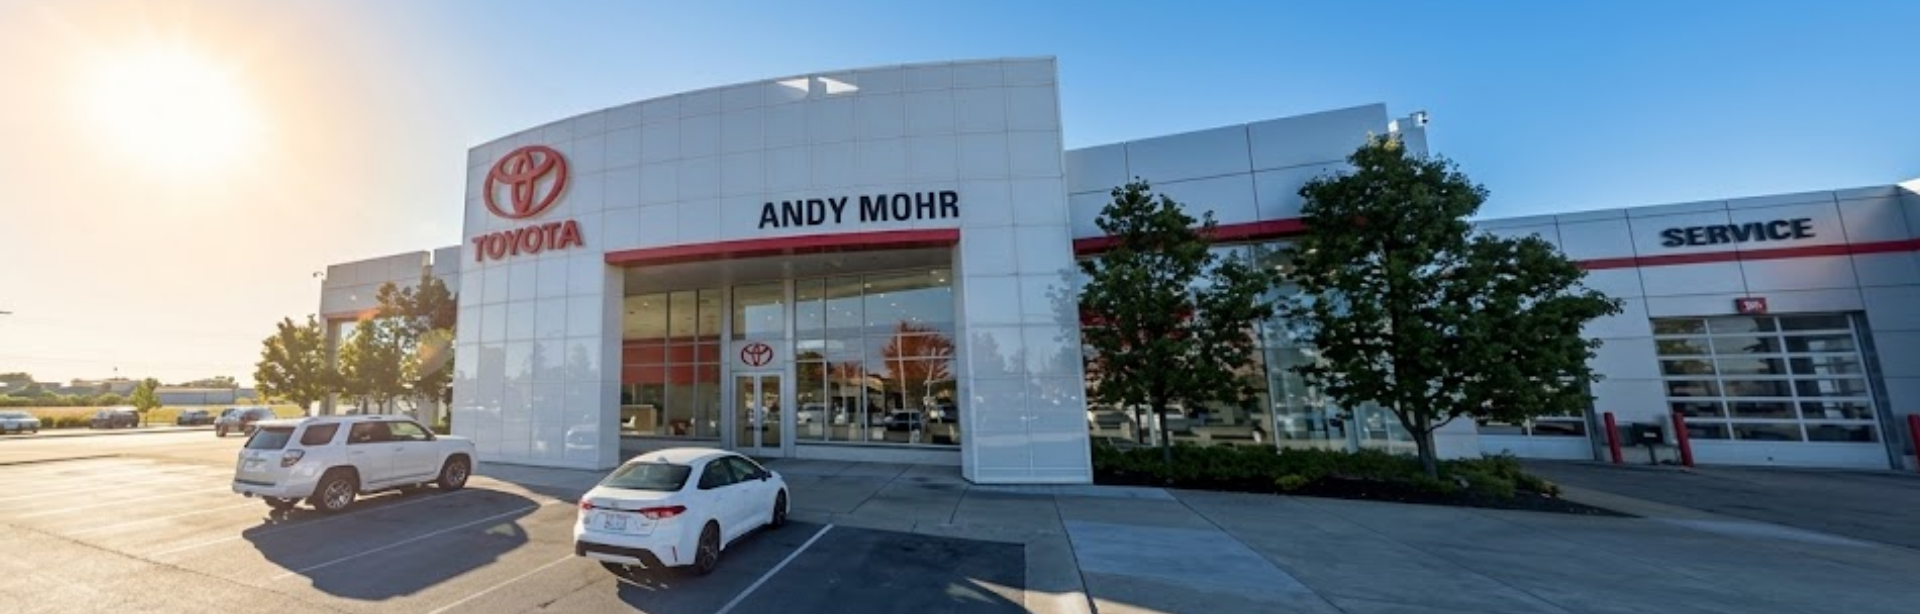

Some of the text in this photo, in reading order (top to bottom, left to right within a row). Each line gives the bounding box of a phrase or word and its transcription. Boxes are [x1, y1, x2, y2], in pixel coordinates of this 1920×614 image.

[758, 190, 960, 229] ANDY MOHR
[472, 219, 583, 262] TOYOTA
[1661, 218, 1815, 247] SERVICE
